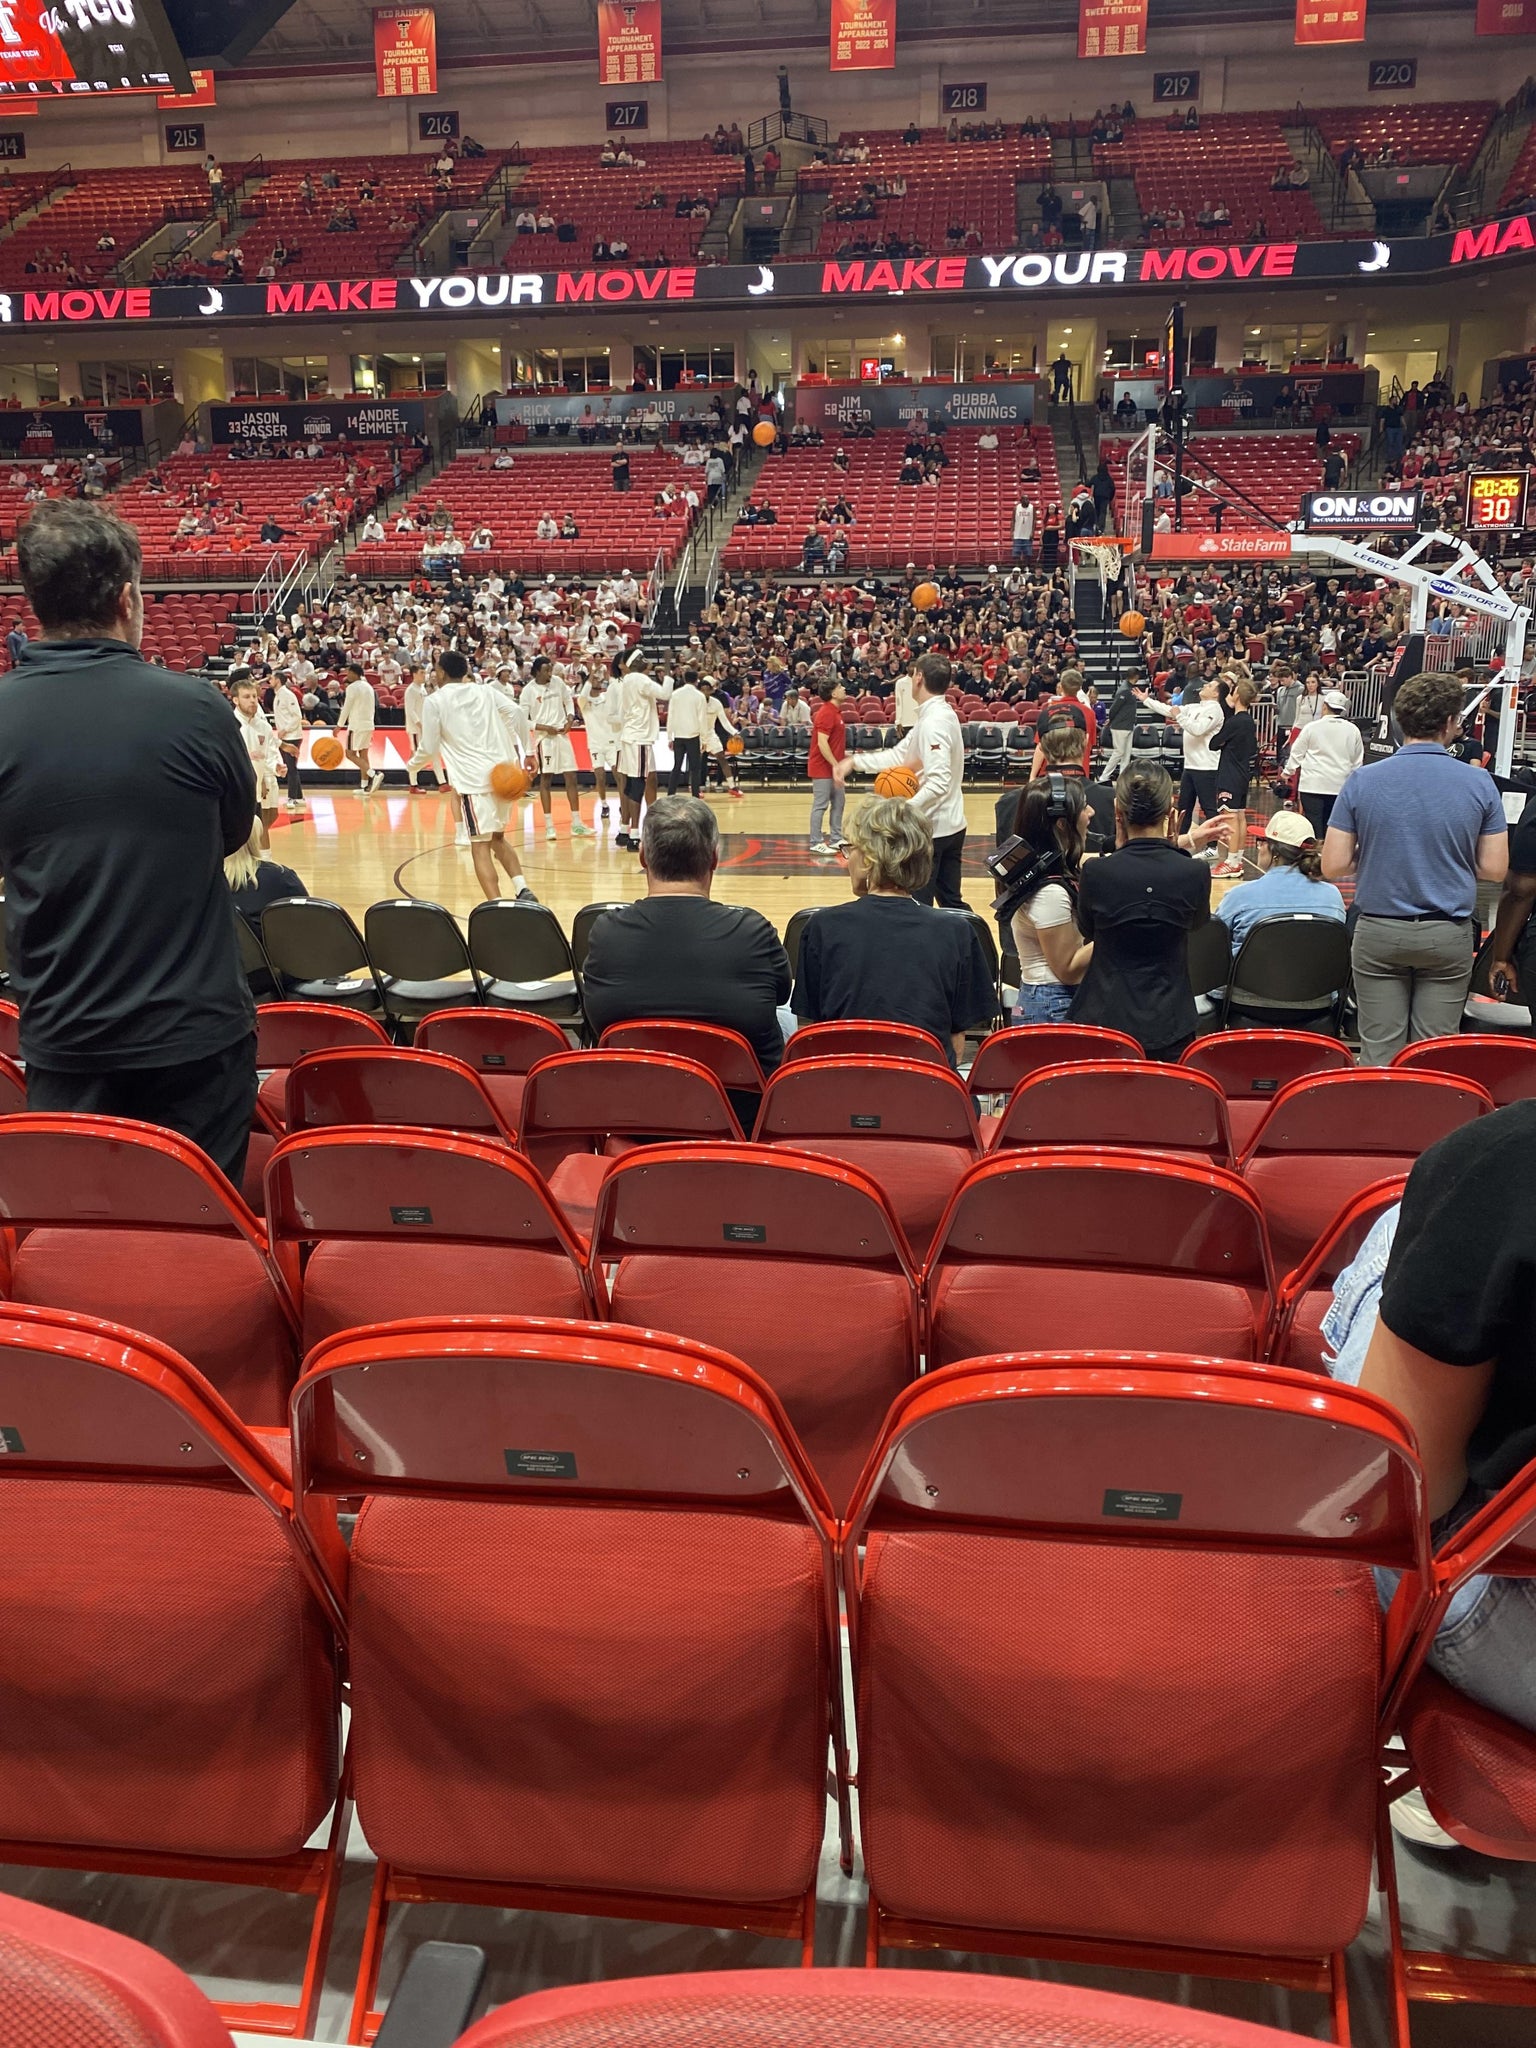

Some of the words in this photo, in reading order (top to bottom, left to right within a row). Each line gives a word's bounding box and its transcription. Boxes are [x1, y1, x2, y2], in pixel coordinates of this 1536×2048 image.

[853, 12, 873, 20] NCAA
[1085, 7, 1109, 16] SWEET
[1111, 5, 1141, 15] SIXTEEN
[1502, 4, 1524, 17] 2019
[620, 27, 639, 35] NCAA
[840, 21, 886, 30] TOURNAMENT
[608, 35, 652, 44] TOURNAMENT
[838, 29, 888, 38] APPEARANCES
[108, 44, 124, 52] TCU
[395, 40, 414, 49] NCAA
[607, 43, 655, 52] APPEARANCES
[22, 50, 39, 58] TECH
[383, 48, 427, 57] TOURNAMENT
[383, 56, 429, 66] APPEARANCES
[1374, 64, 1412, 85] 220
[1162, 76, 1191, 97] 219
[951, 88, 978, 108] 218
[614, 106, 639, 126] 217
[426, 116, 452, 136] 216
[173, 128, 198, 148] 215
[821, 257, 967, 293] MAKE
[981, 251, 1128, 287] YOUR
[1140, 244, 1298, 281] MOVE
[267, 280, 398, 313] MAKE
[410, 273, 544, 308] YOUR
[556, 268, 697, 302] MOVE
[24, 288, 151, 321] MOVE
[838, 396, 860, 409] JIM
[953, 393, 997, 406] BUBBA
[523, 405, 551, 417] RICK
[825, 403, 837, 415] 58
[945, 403, 951, 412] 4
[953, 406, 1017, 420] JENNINGS
[241, 412, 280, 425] JASON
[359, 409, 399, 421] ANDRE
[229, 421, 241, 433] 33
[304, 423, 331, 434] HONOR
[347, 416, 358, 428] 14
[359, 421, 408, 434] EMMETT
[242, 424, 288, 437] SASSER
[1473, 479, 1520, 498] 20:26
[1480, 498, 1511, 521] 30
[1353, 551, 1400, 571] LEGACY
[1459, 590, 1509, 612] SPORTS
